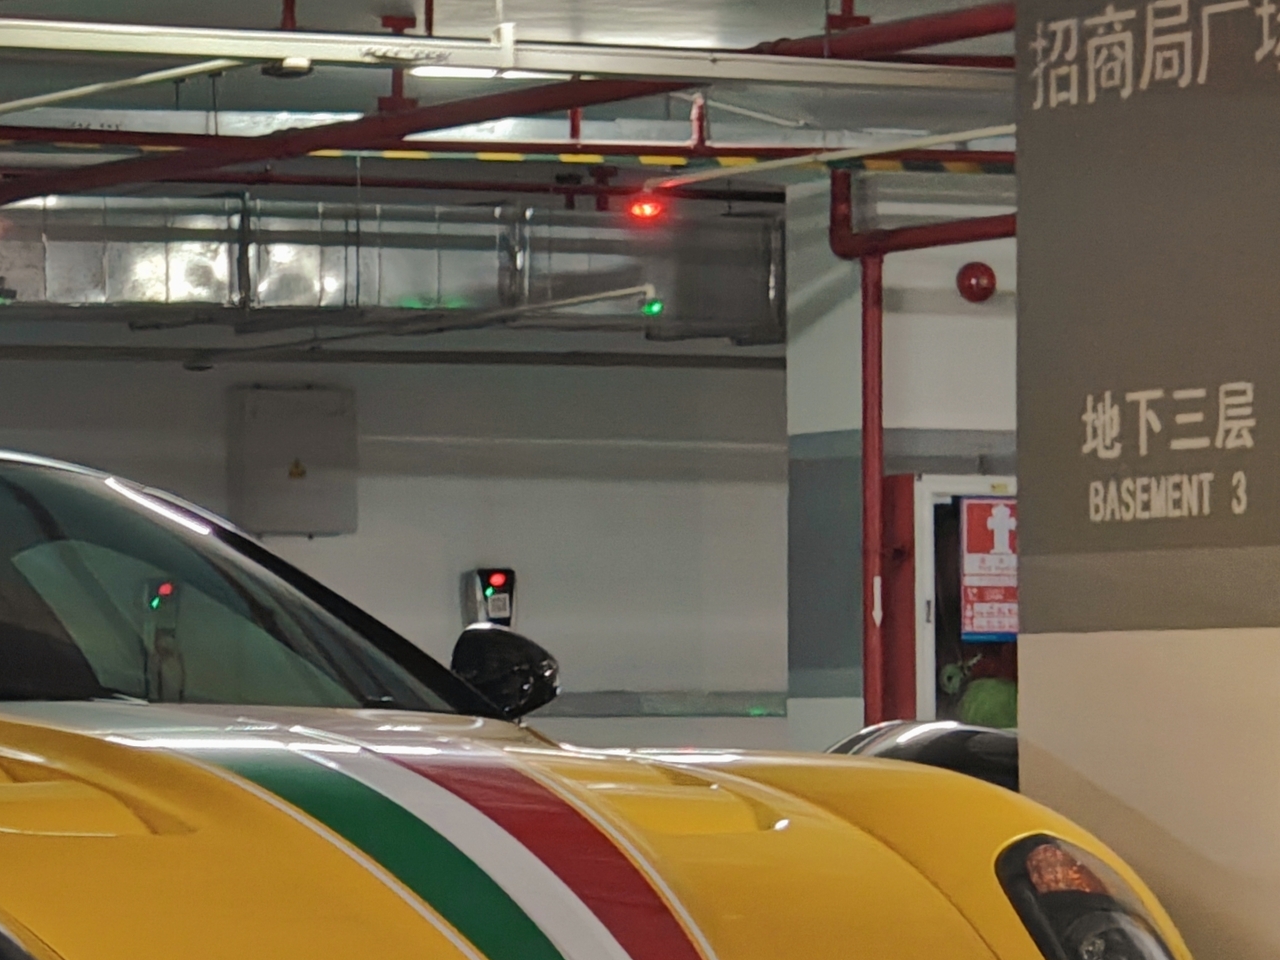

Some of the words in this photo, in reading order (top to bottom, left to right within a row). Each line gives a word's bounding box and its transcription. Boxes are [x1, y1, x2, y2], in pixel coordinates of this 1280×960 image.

[1081, 381, 1257, 459] 地下三层
[1089, 473, 1214, 522] BASEMENT
[1231, 471, 1248, 514] 3
